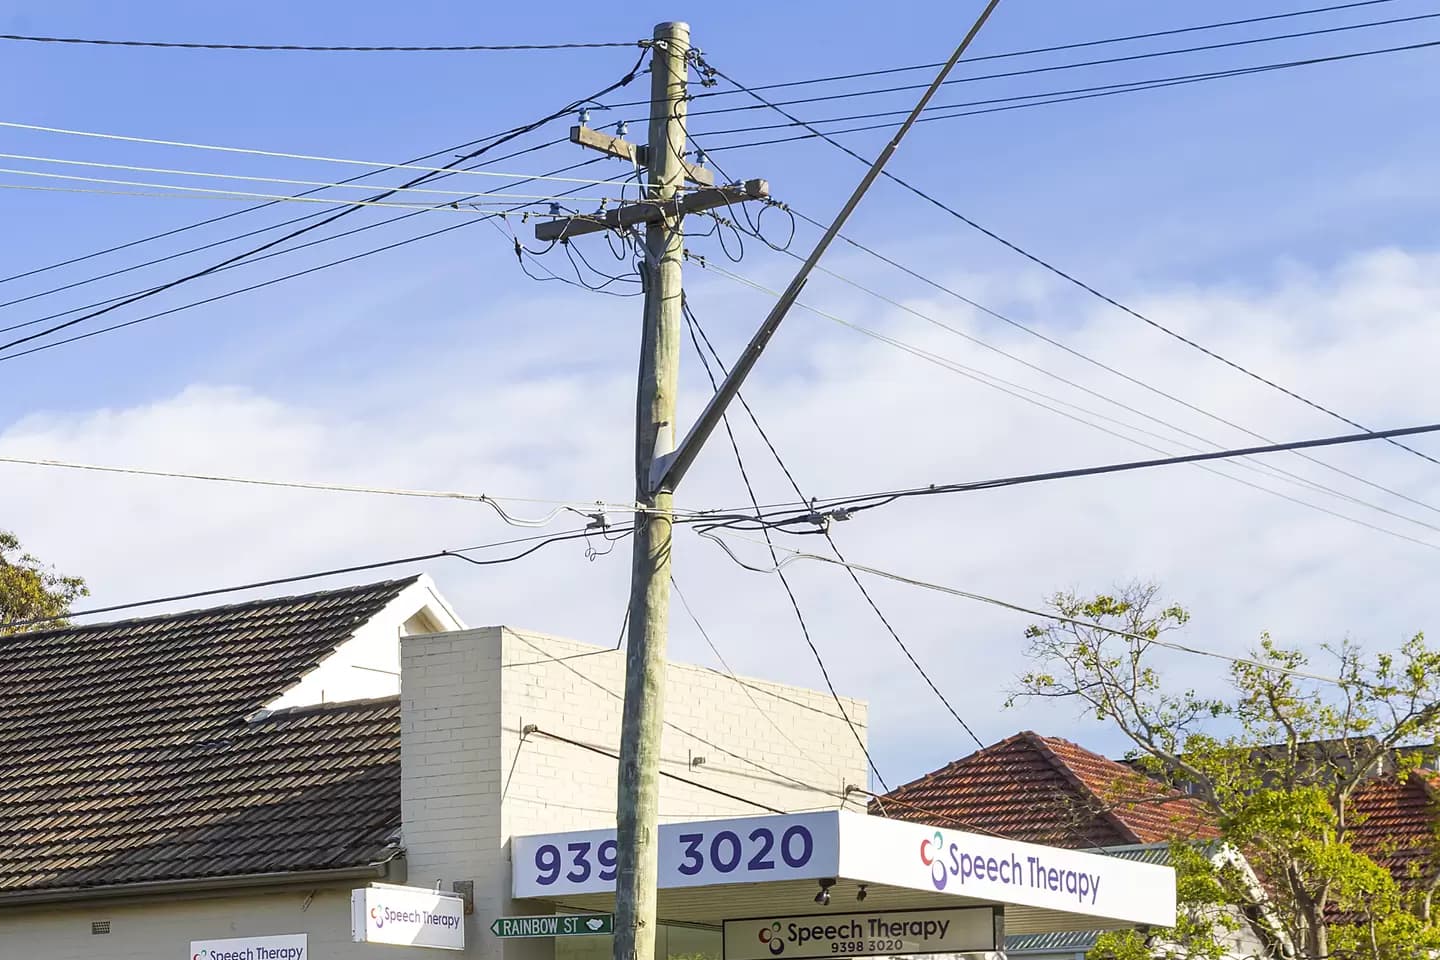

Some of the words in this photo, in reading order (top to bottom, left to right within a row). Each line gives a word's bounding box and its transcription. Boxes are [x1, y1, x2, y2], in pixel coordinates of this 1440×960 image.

[534, 839, 617, 886] 939
[677, 825, 814, 876] 3020
[950, 843, 1022, 888] Speech
[1027, 856, 1100, 904] Therapy
[384, 906, 421, 925] Speech
[423, 911, 460, 930] Therapy
[503, 918, 558, 935] RAINBOW
[563, 917, 579, 933] ST
[787, 920, 863, 946] Speech
[868, 918, 950, 940] Therapy
[256, 947, 303, 960] Therapy
[831, 941, 864, 953] 9398
[869, 939, 903, 952] 3020
